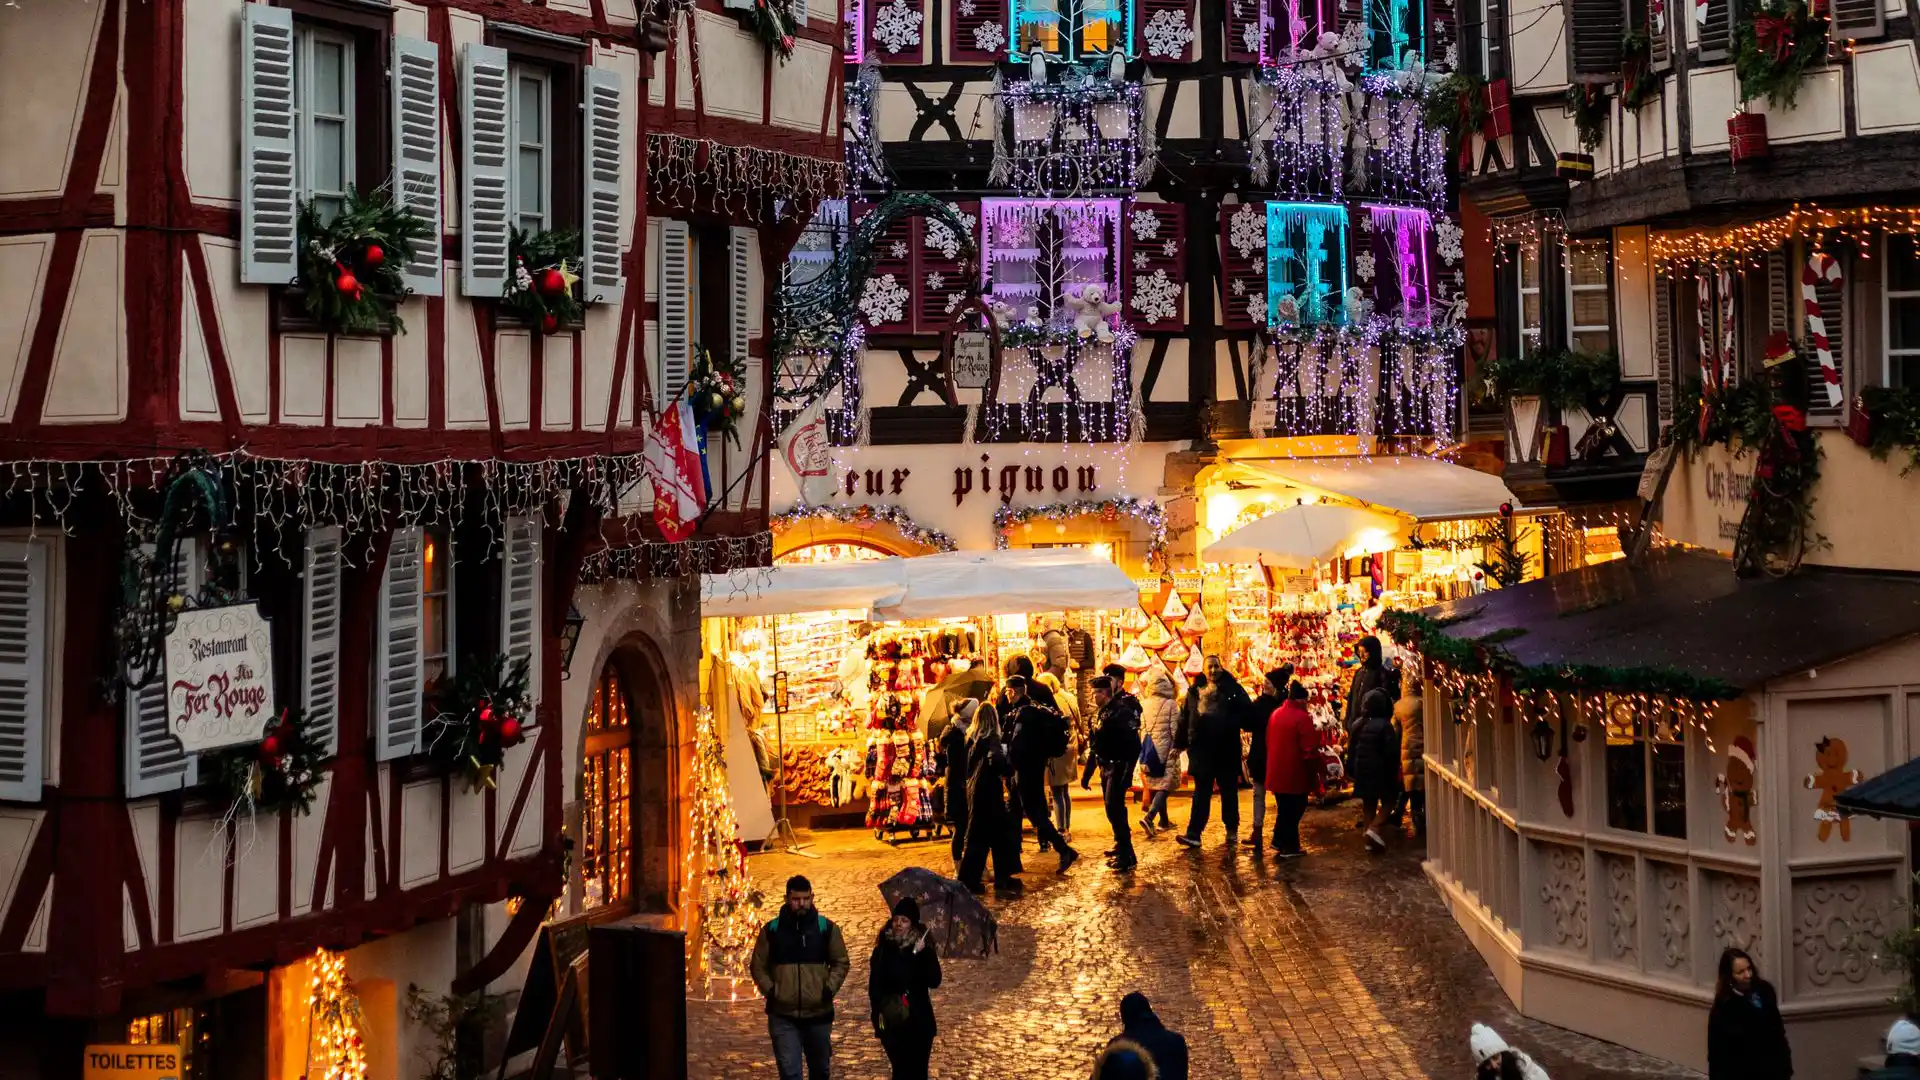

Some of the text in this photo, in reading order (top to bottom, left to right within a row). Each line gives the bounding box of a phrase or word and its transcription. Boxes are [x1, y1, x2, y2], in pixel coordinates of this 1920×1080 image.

[830, 453, 1097, 507] eux pignon
[189, 633, 248, 662] Restaurant
[233, 662, 253, 682] Au
[171, 670, 266, 733] Fer Rouge
[90, 1054, 176, 1069] TOILETTES
